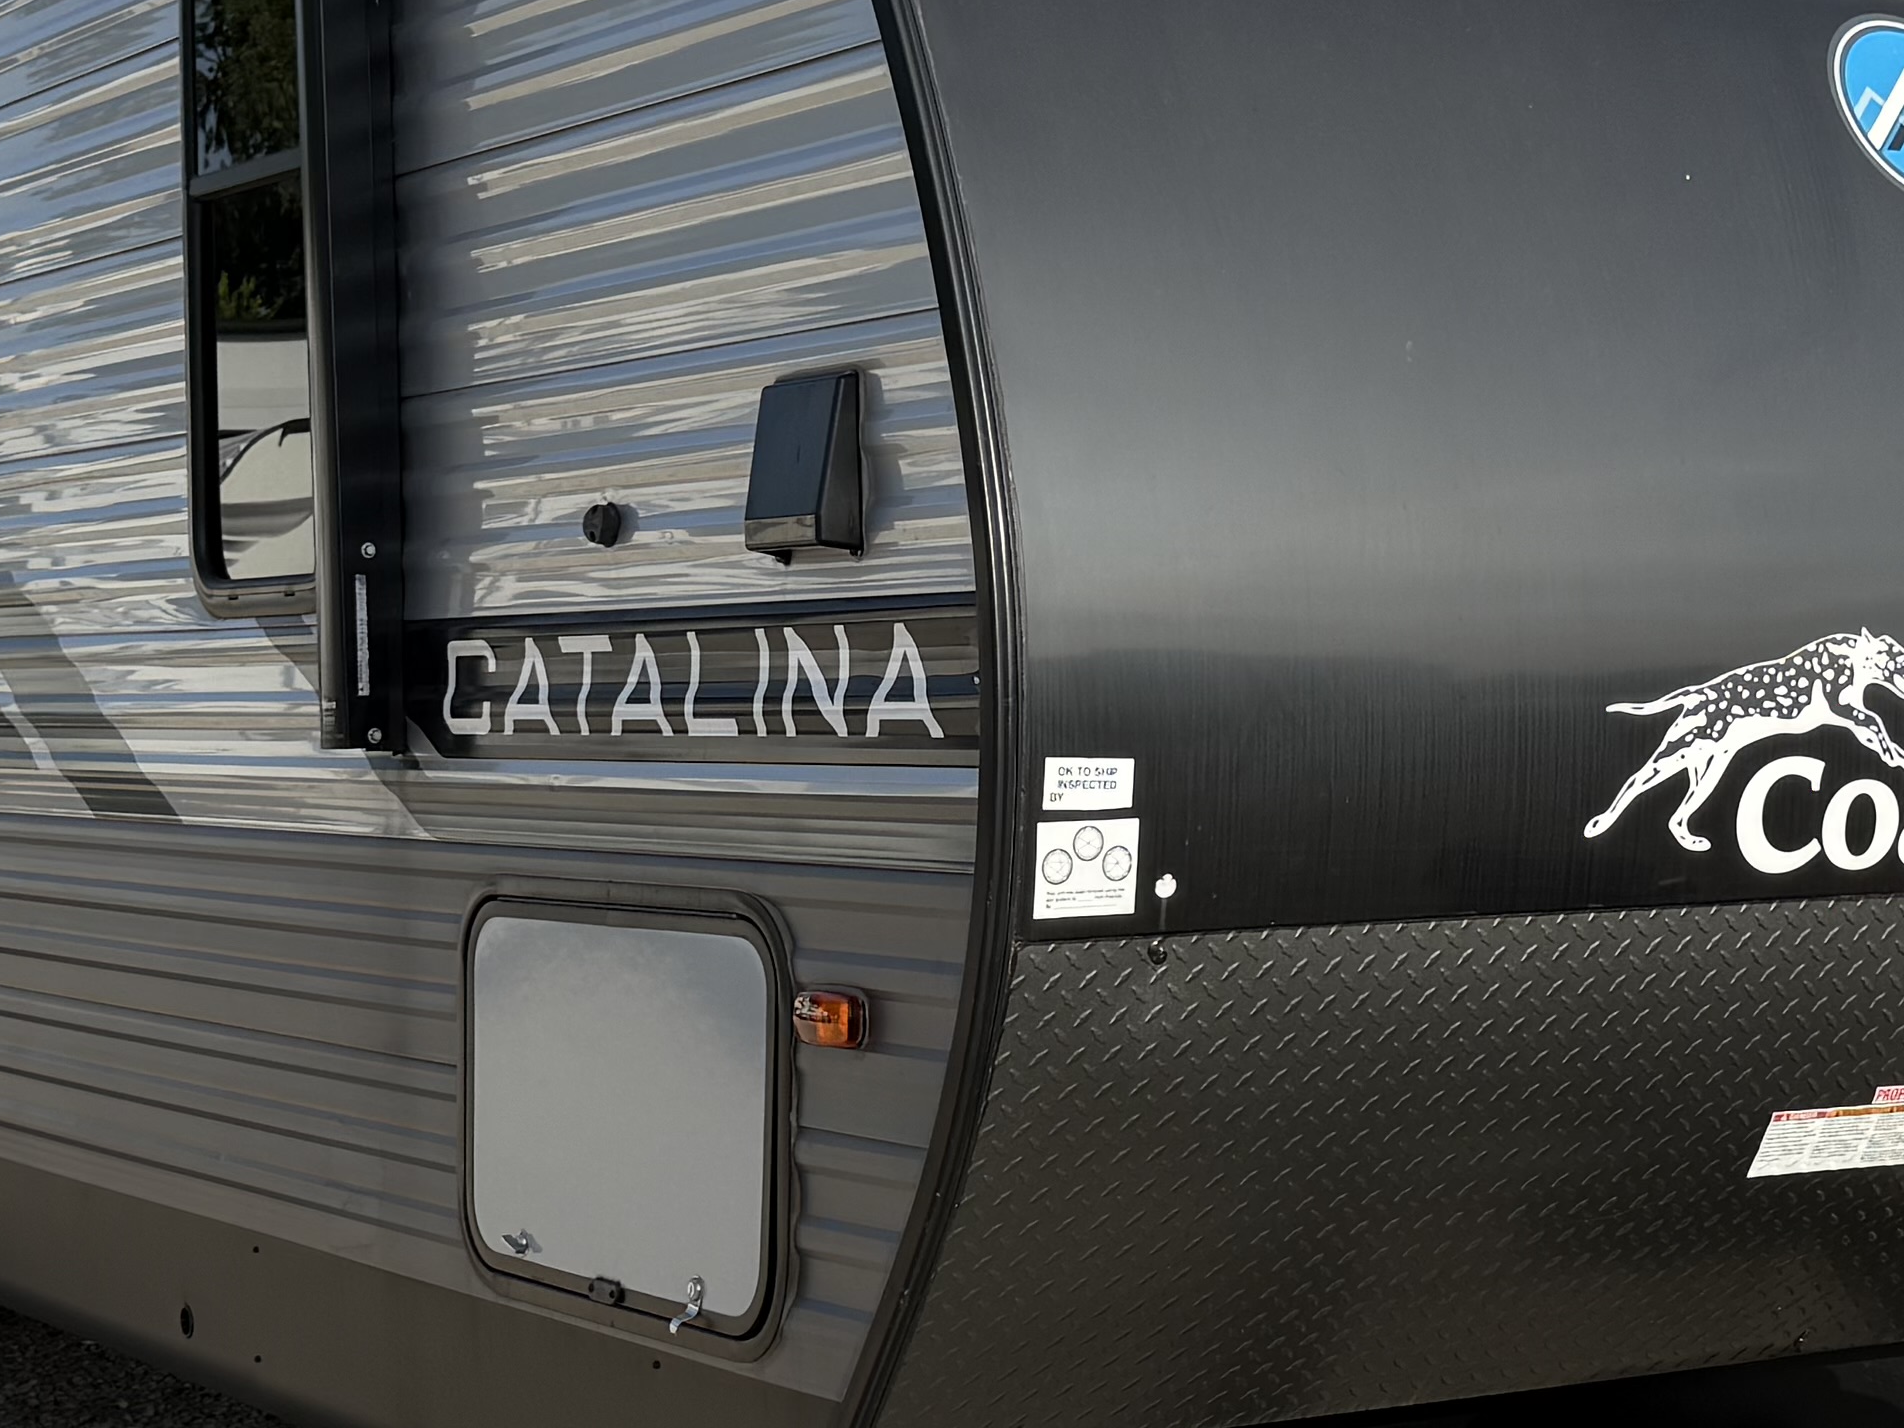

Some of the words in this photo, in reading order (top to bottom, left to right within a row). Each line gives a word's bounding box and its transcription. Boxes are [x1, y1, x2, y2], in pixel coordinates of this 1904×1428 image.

[442, 622, 946, 738] CATALINA
[1078, 766, 1091, 777] TO
[1057, 779, 1117, 790] INSPECTED
